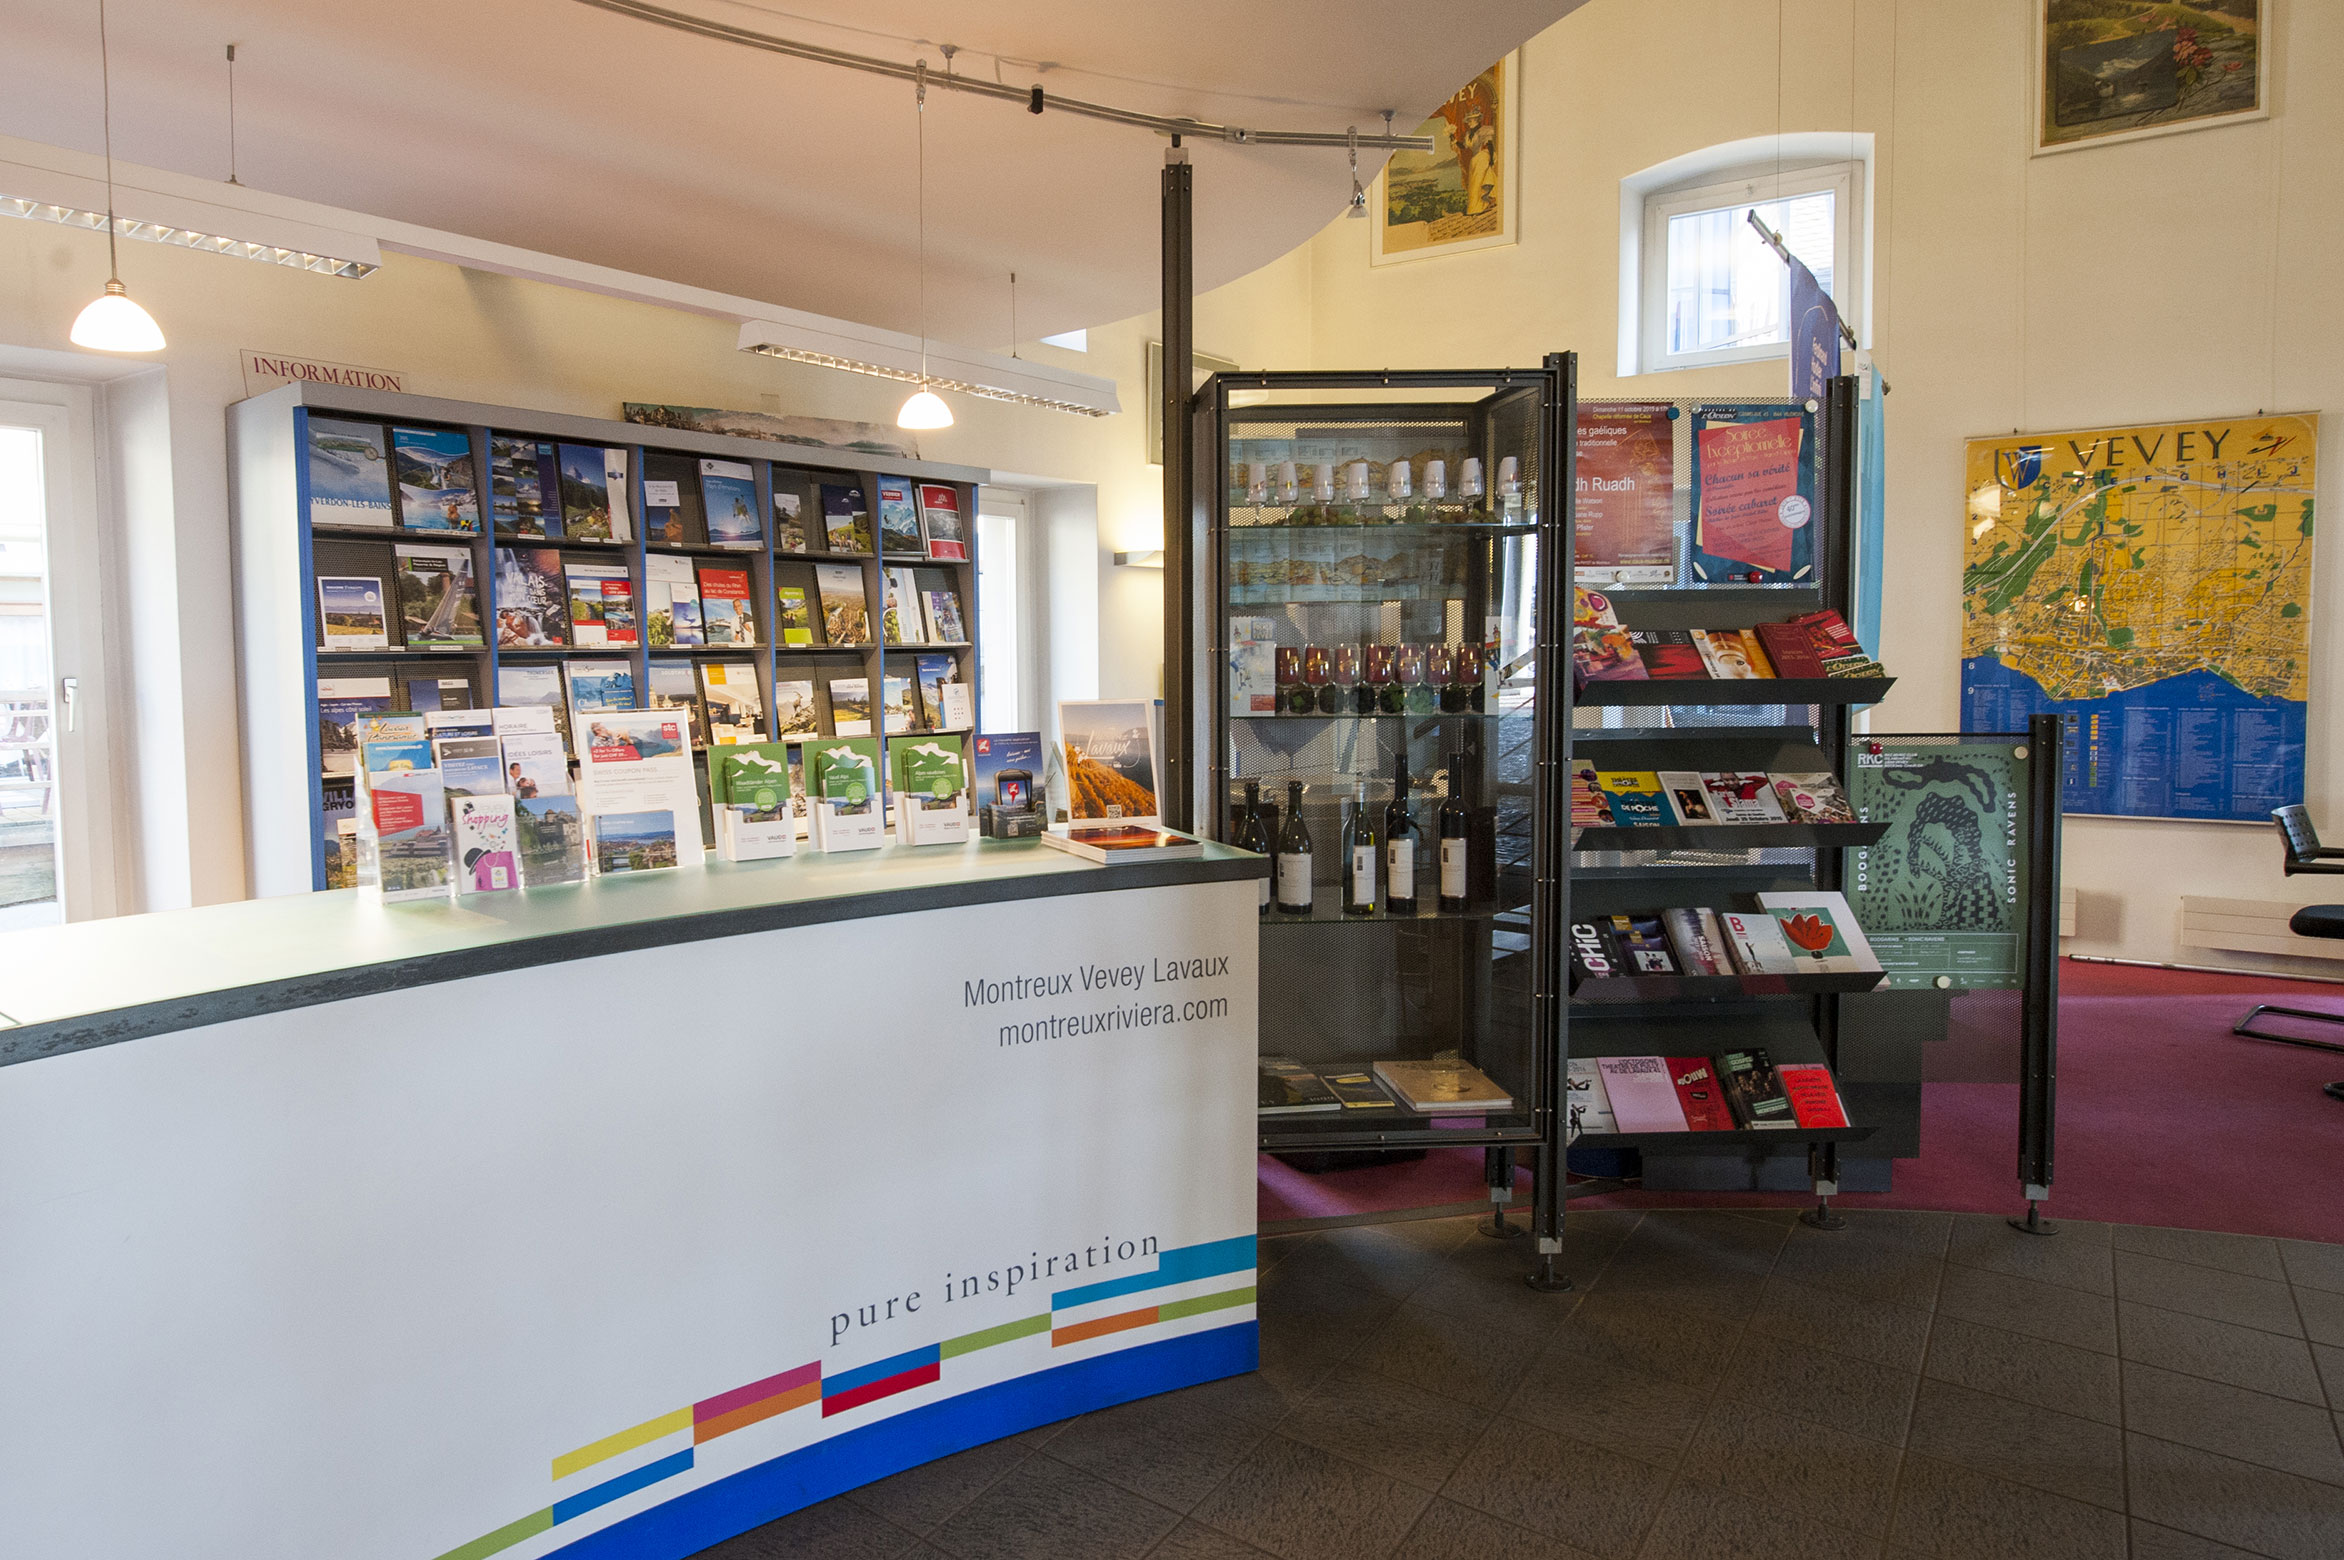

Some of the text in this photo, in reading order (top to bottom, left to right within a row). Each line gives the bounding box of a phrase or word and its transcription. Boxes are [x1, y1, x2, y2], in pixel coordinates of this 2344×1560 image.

[254, 357, 401, 392] INFORMATION
[1589, 426, 1627, 437] gaéliques
[1726, 427, 1767, 442] Soirée
[1707, 434, 1792, 460] Exceptionnelle
[2069, 429, 2230, 469] VEVEY
[1592, 477, 1635, 491] Ruadh
[1705, 472, 1744, 486] Chacun
[1762, 463, 1791, 476] vérité
[2043, 482, 2050, 490] C
[2110, 476, 2118, 485] E
[2144, 475, 2152, 483] F
[2180, 472, 2189, 481] G
[2218, 470, 2226, 479] H
[2290, 466, 2297, 475] J
[1706, 504, 1736, 516] Soirée
[1738, 497, 1778, 511] cabaret
[1968, 662, 1975, 670] 8
[528, 749, 552, 757] LOISIRS
[1086, 730, 1131, 757] Lavaux
[1858, 753, 1883, 764] RKC
[462, 814, 508, 830] Shopping
[2008, 792, 2017, 904] SONIC RAVENS
[1729, 916, 1745, 932] B
[1699, 935, 1712, 962] SAISON
[964, 956, 1229, 1008] Montreux Vevey Lavaux
[1000, 997, 1228, 1047] montreuxriviera.com
[830, 1234, 1159, 1348] pure inspiration
